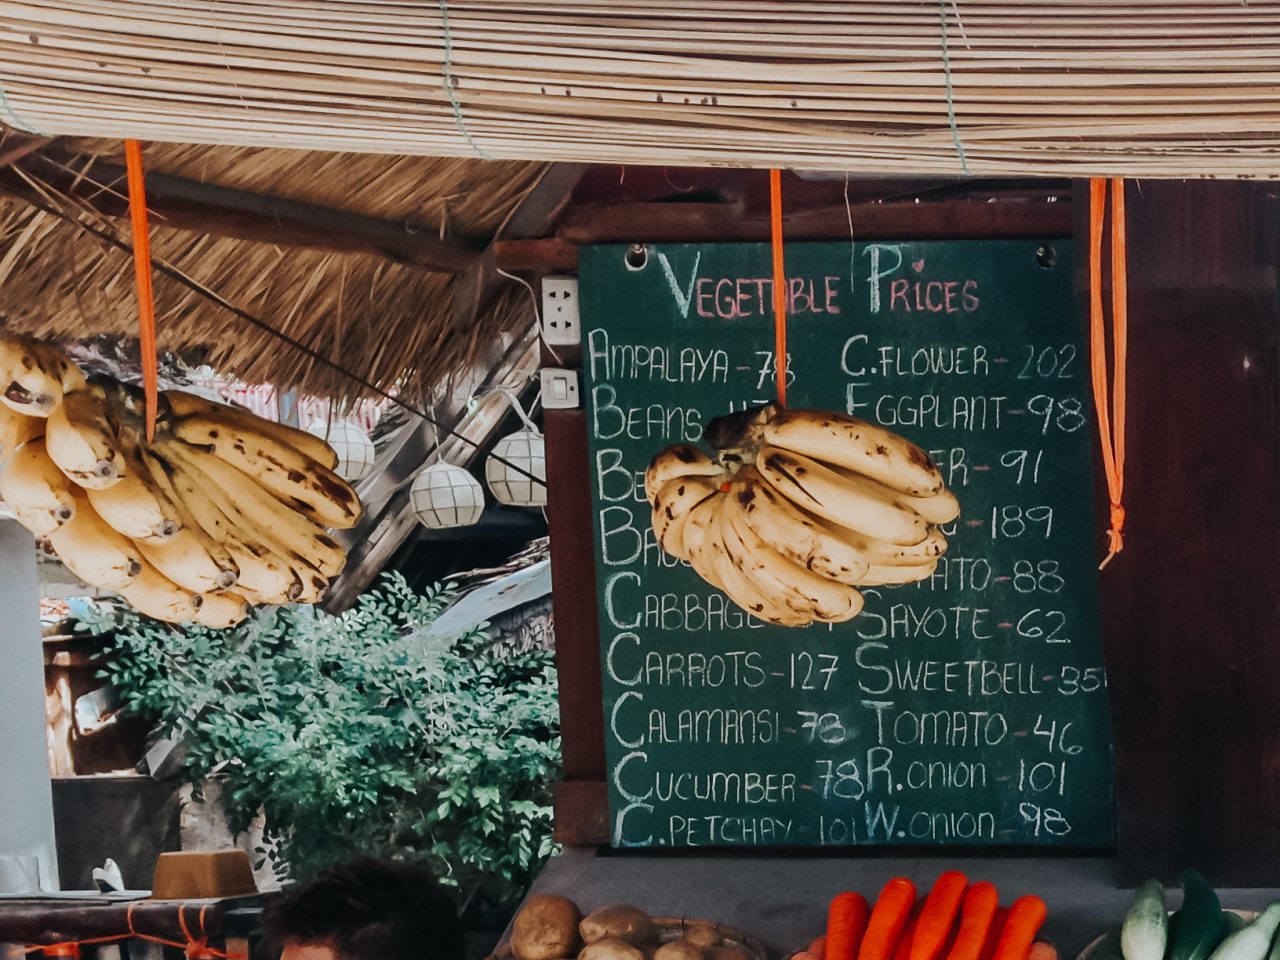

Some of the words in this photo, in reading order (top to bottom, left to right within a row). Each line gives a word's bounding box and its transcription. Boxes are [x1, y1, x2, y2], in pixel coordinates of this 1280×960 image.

[658, 251, 840, 318] VEGETBLE
[861, 243, 980, 314] PRICES
[588, 328, 729, 383] AMPALAYA
[840, 334, 989, 377] C.FLOWER
[1016, 344, 1077, 379] 202
[592, 383, 703, 442] BEANS
[1027, 395, 1086, 435] 98
[1000, 450, 1044, 485] 91
[991, 505, 1053, 539] 189
[1013, 559, 1065, 594] 88
[856, 589, 993, 640] SAYOTE
[1016, 609, 1071, 643] 62
[606, 632, 767, 688] CARROTS
[790, 652, 839, 691] 127
[855, 642, 1042, 696] SWEETBELL
[610, 691, 779, 749] CALAMANSI
[861, 700, 1009, 746] TOMATO
[1033, 714, 1084, 755] 46
[613, 751, 797, 803] CUCUMBER
[816, 758, 865, 800] 78
[1018, 758, 1066, 796] 101
[611, 802, 793, 848] C.PETCHAY
[819, 815, 856, 845] 101
[1018, 802, 1072, 836] 98
